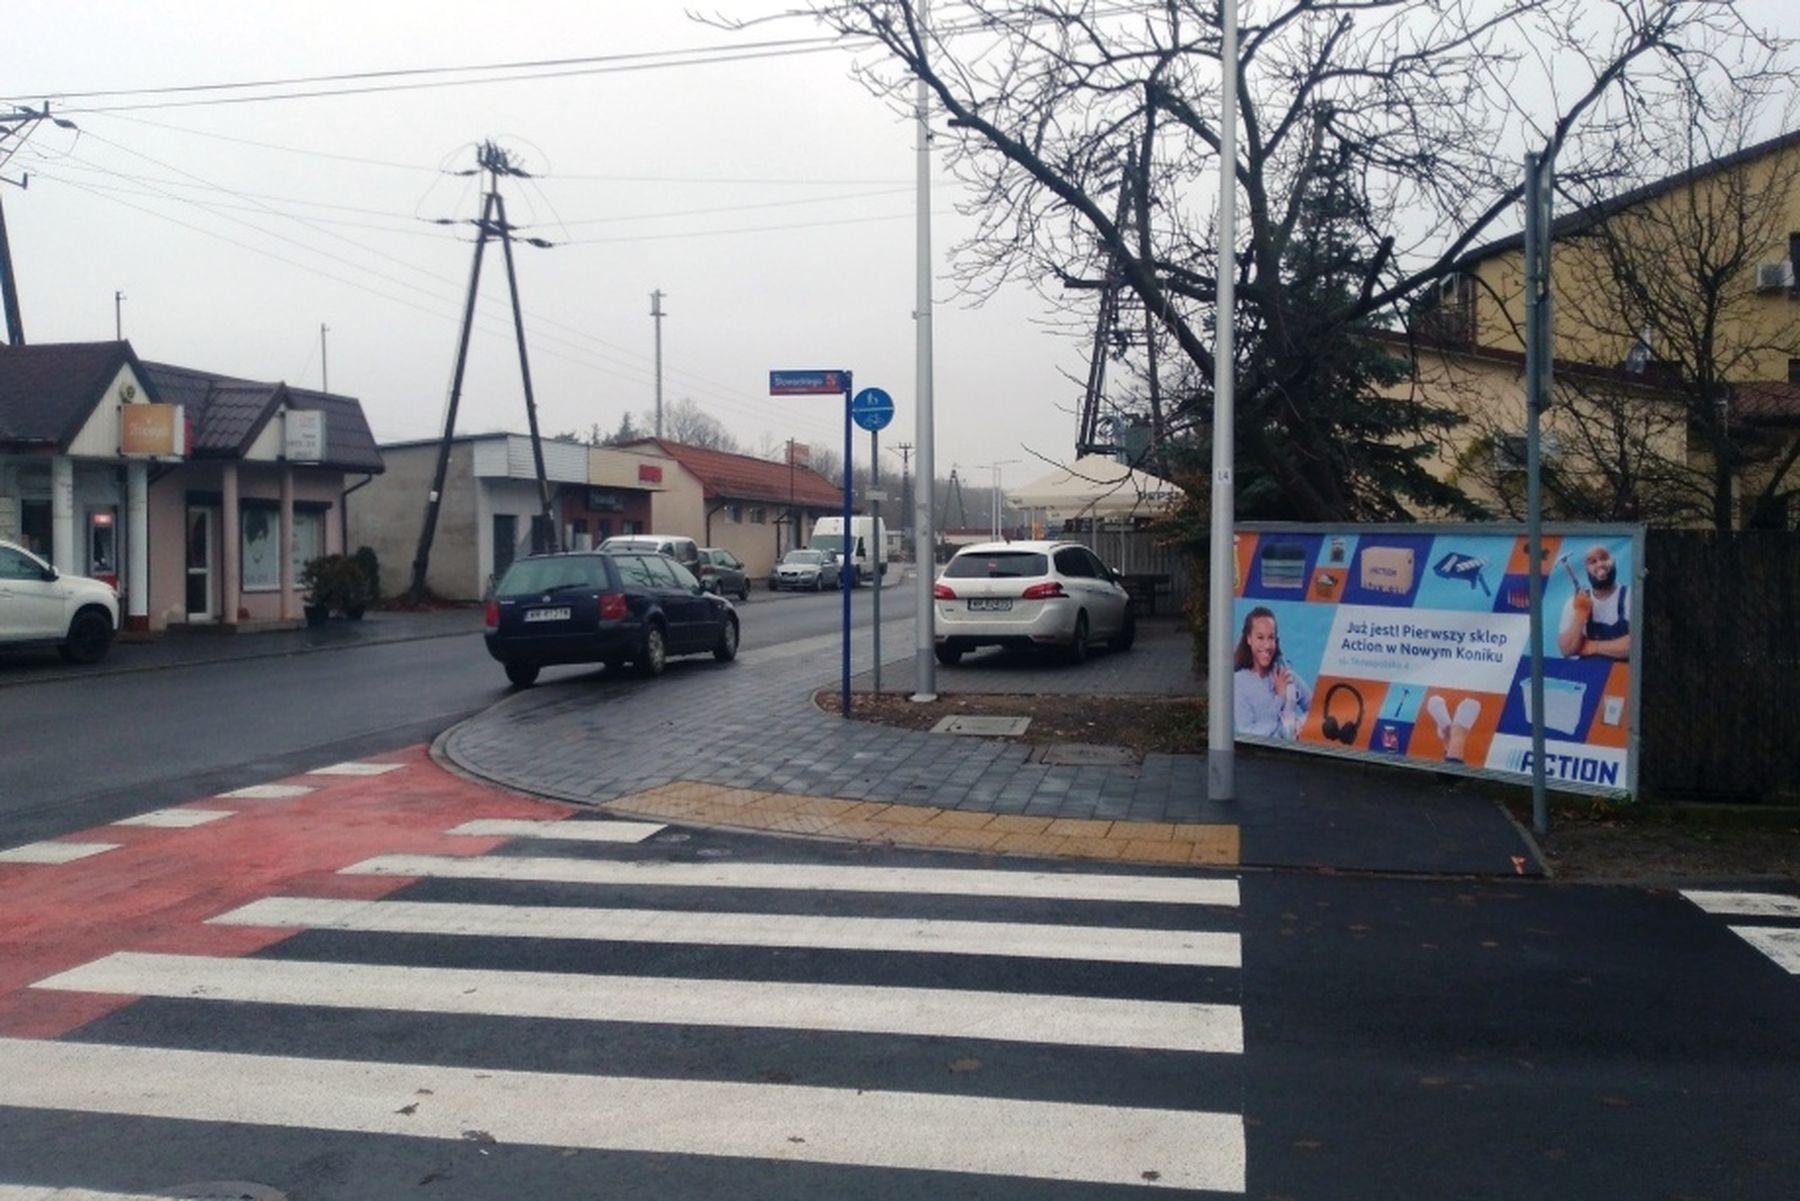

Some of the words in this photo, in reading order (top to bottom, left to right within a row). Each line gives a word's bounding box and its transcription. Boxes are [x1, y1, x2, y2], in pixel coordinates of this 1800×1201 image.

[1346, 621, 1368, 634] Już
[1370, 623, 1400, 638] jest!
[1402, 624, 1466, 644] Pierwszy
[1469, 629, 1508, 648] sklep
[1341, 638, 1384, 653] Action
[1386, 644, 1397, 654] w
[1400, 643, 1452, 660] Nowym
[1456, 647, 1504, 663] Koniku
[1520, 750, 1619, 785] ACTION
